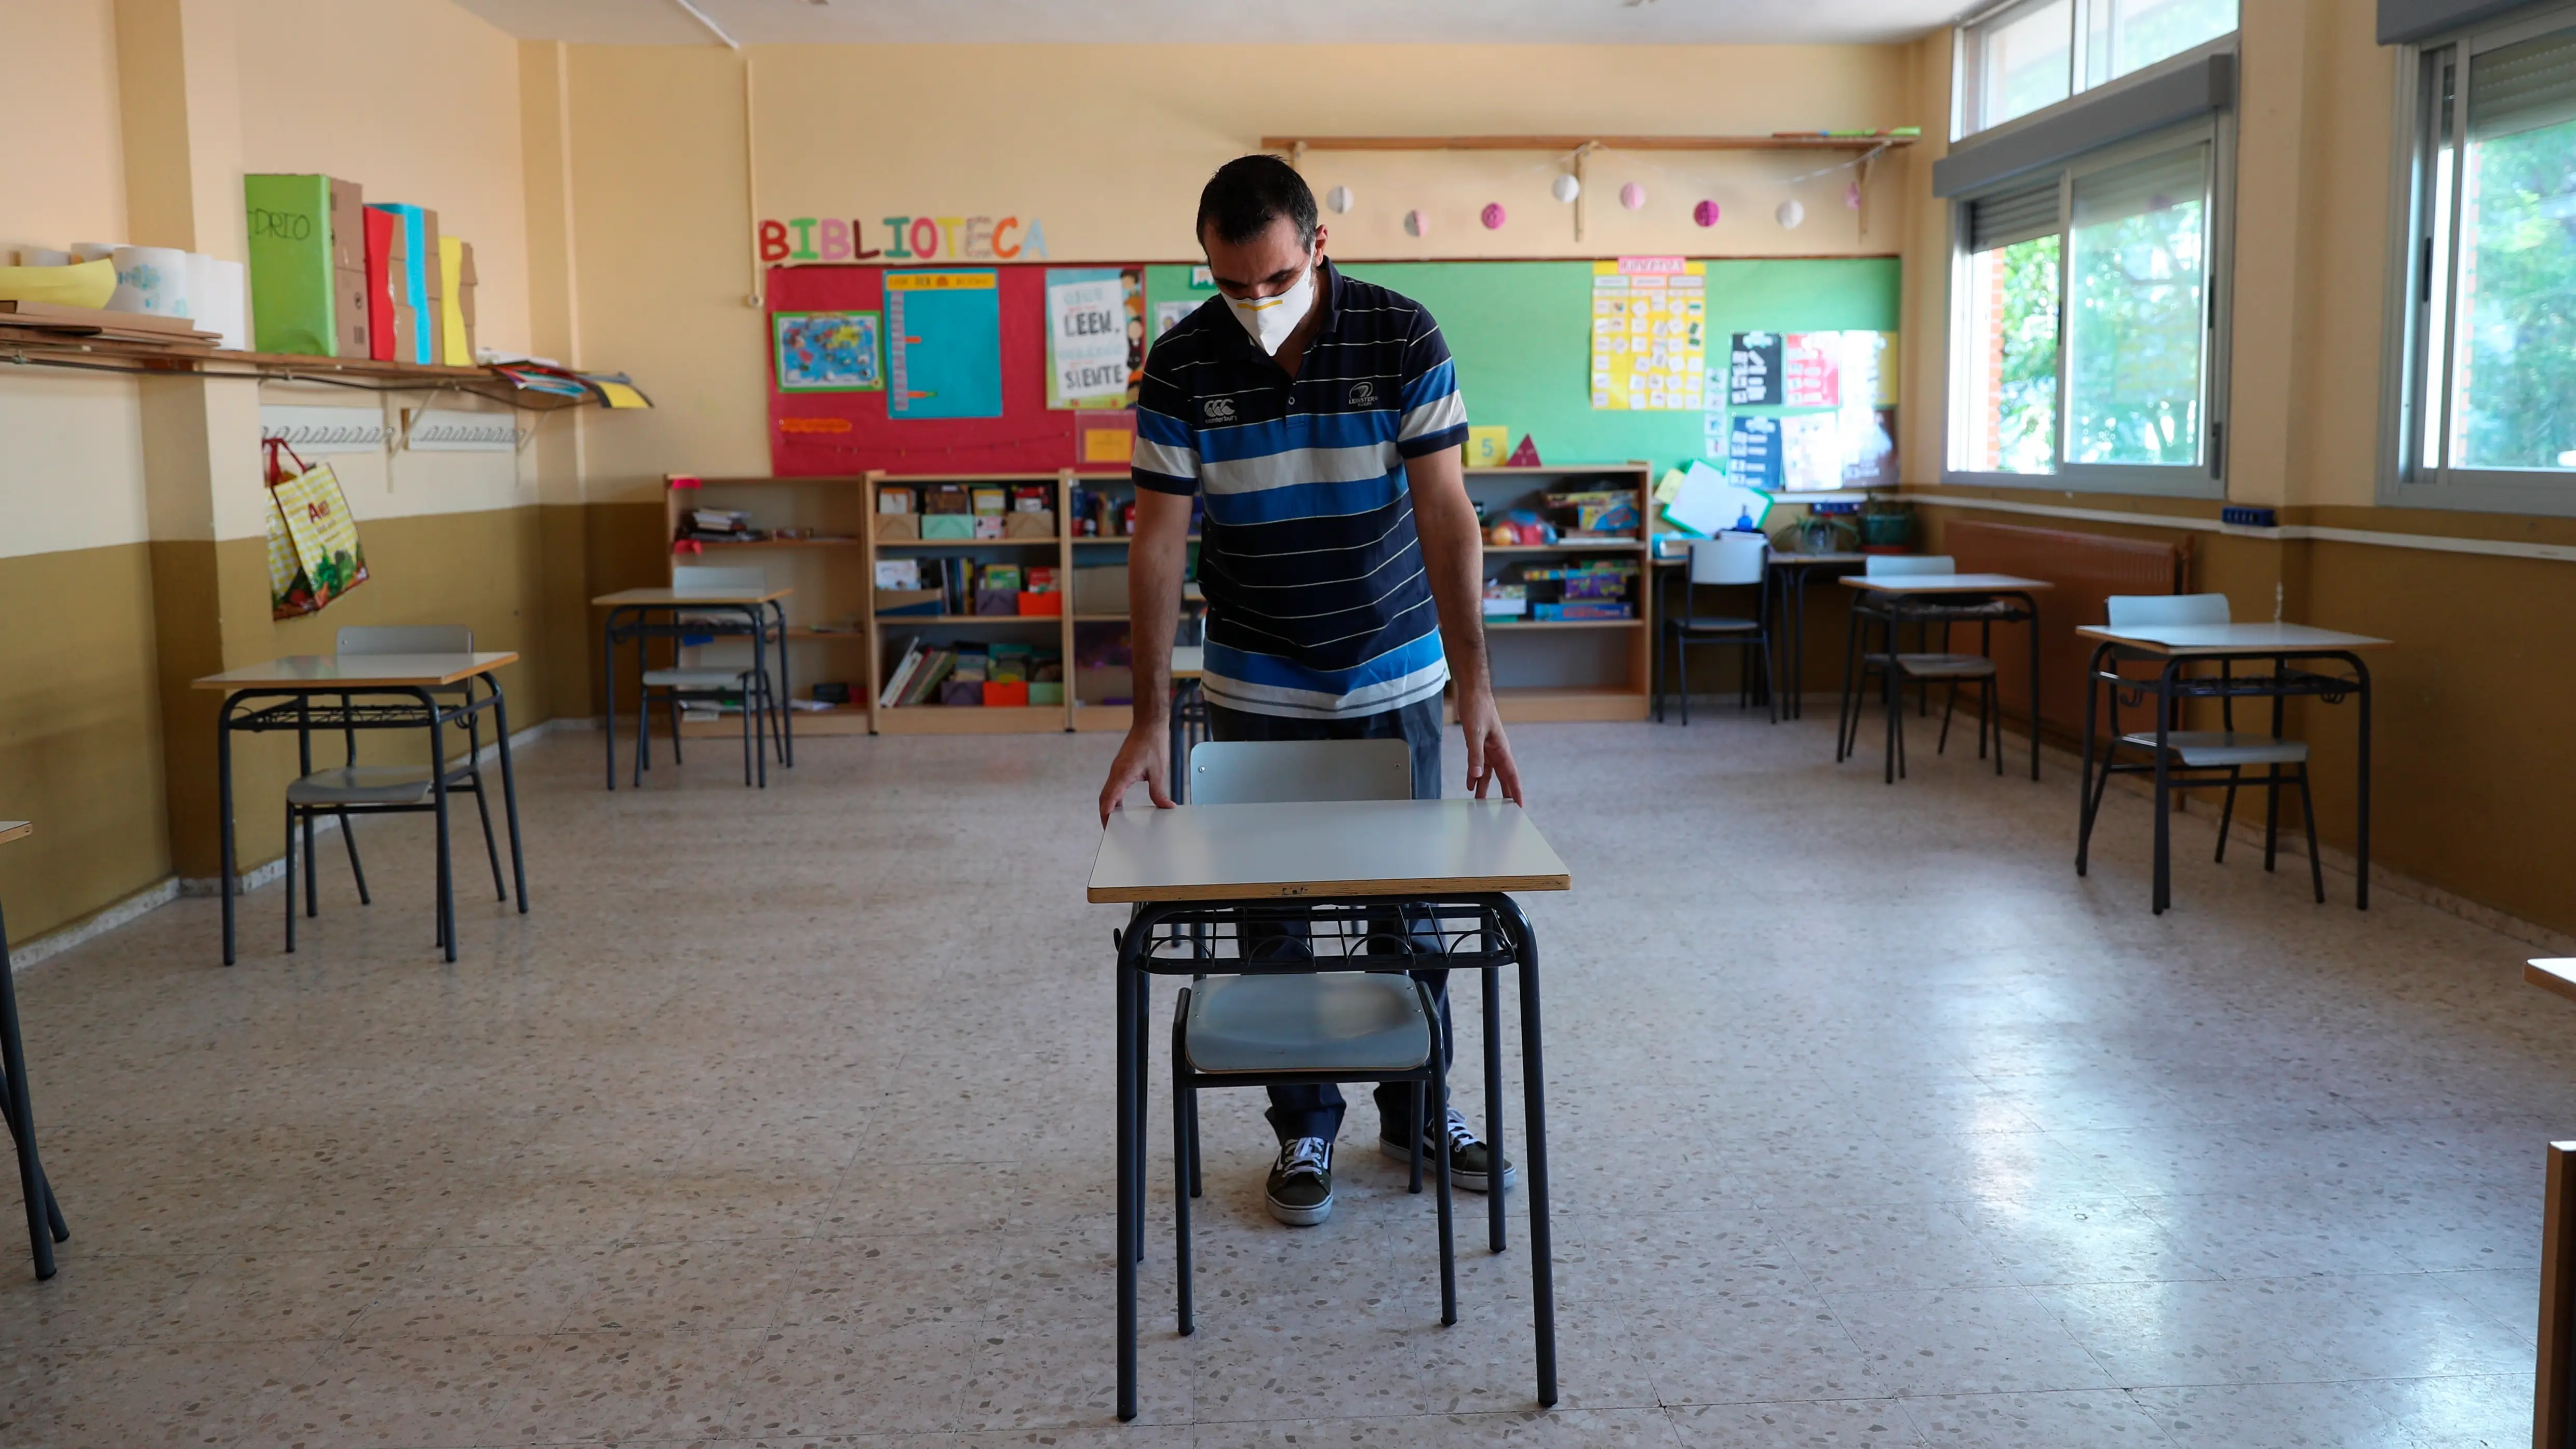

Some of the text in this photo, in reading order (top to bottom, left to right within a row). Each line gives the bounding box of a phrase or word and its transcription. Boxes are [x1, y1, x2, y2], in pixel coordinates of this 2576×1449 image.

[247, 208, 311, 240] DRIO
[758, 217, 1049, 261] BIBLIOTECA
[1065, 365, 1123, 390] SIENTE
[1482, 438, 1494, 458] 5
